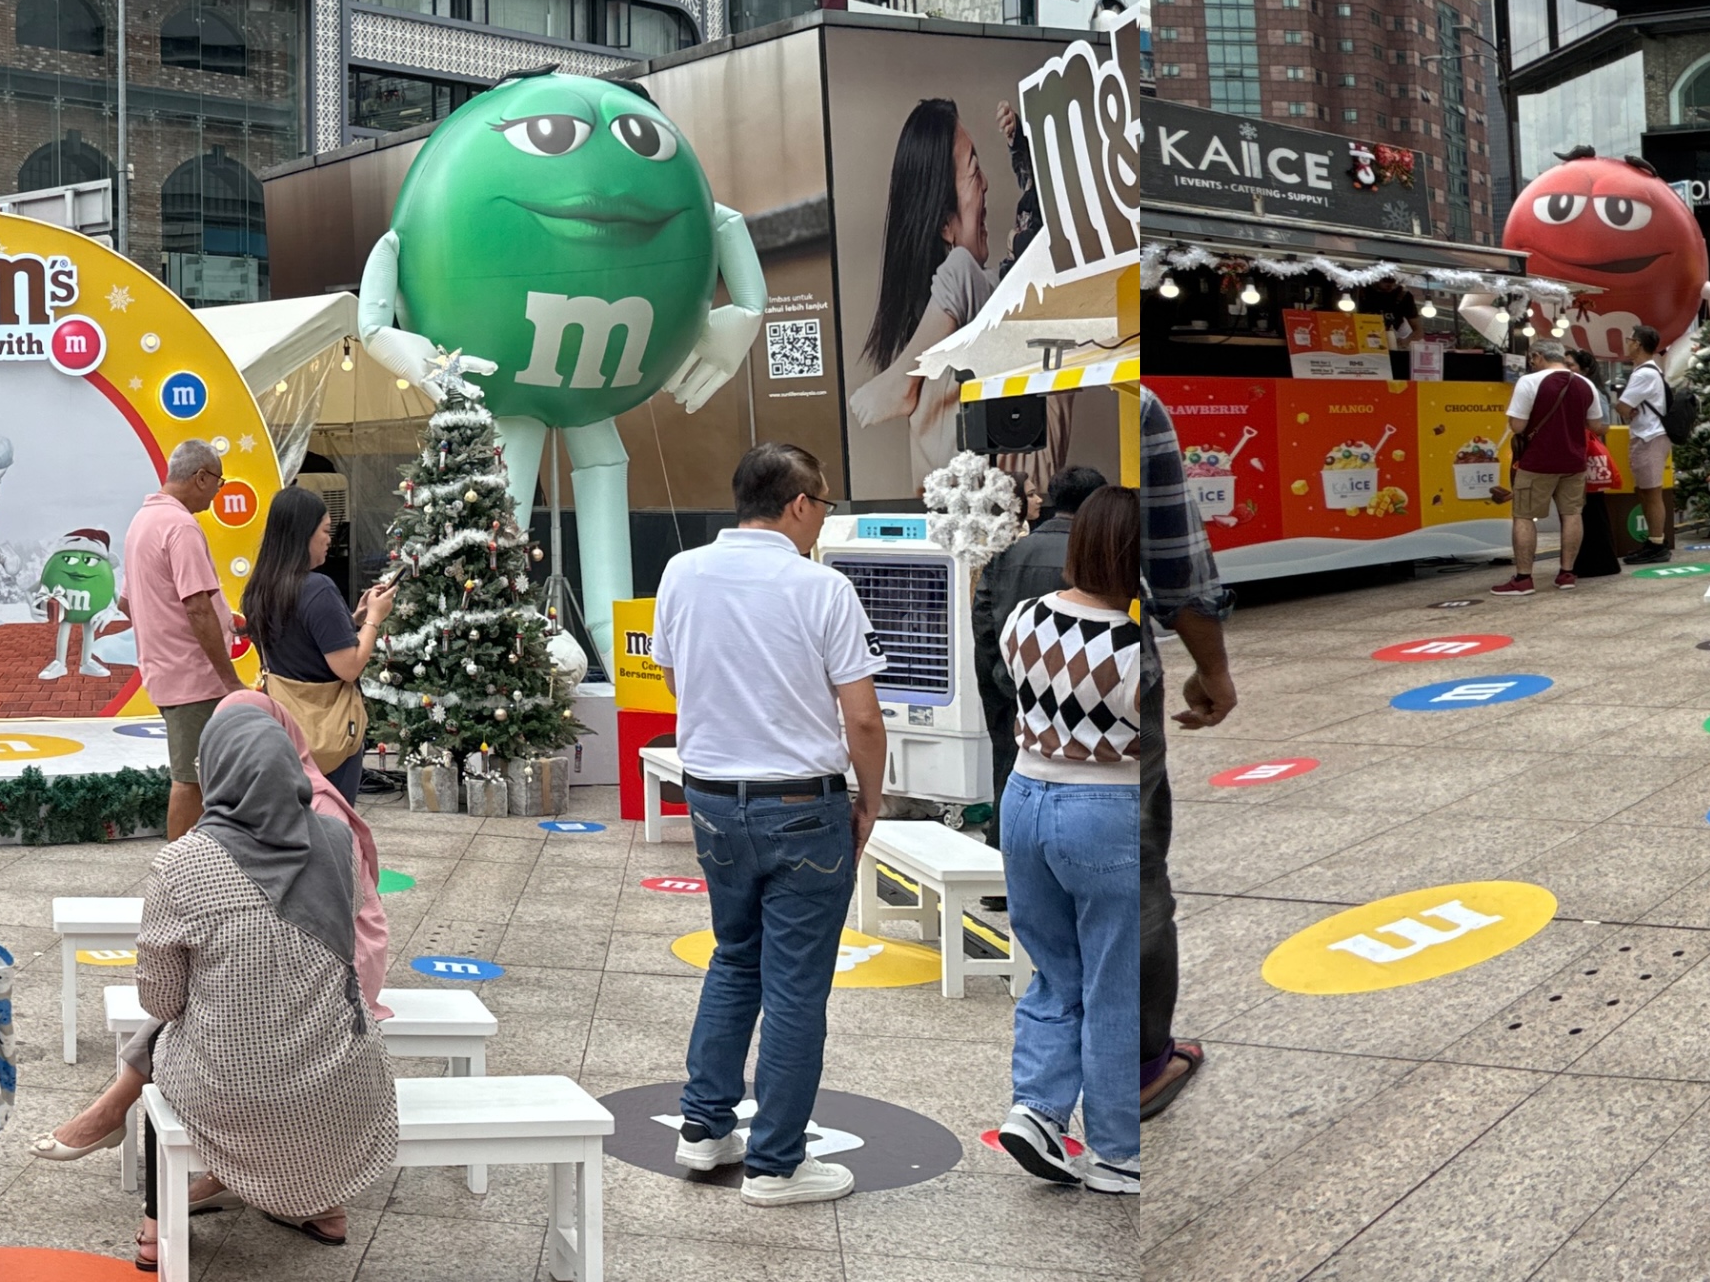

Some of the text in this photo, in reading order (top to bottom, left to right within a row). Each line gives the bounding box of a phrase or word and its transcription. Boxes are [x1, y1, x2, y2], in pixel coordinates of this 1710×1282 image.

[1180, 175, 1324, 205] EVENTS CATERING SUPPLY
[65, 331, 87, 353] m
[515, 291, 653, 388] m
[1329, 405, 1374, 415] MANGO
[1444, 404, 1505, 414] CHOCOLATE
